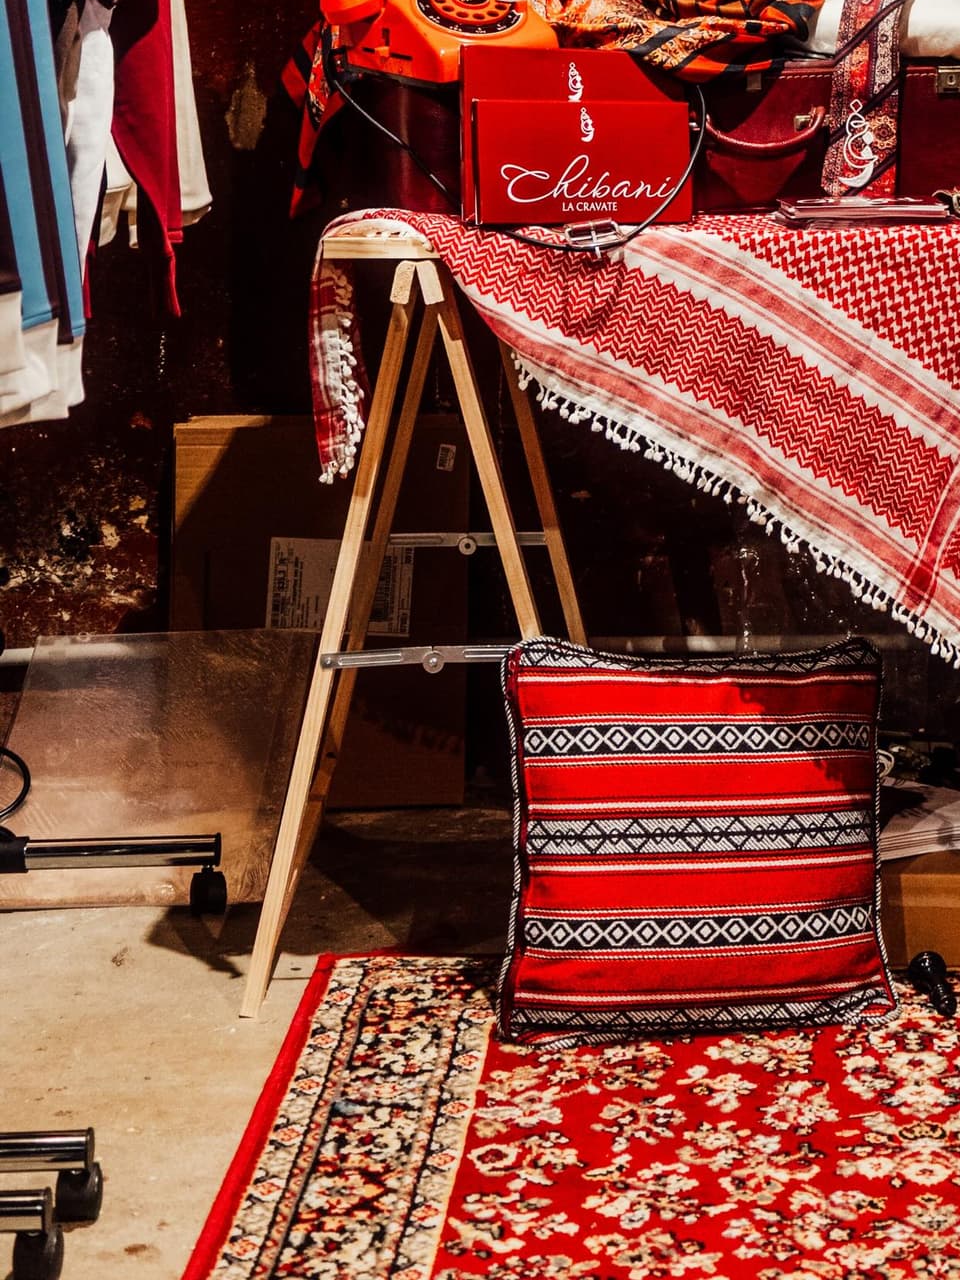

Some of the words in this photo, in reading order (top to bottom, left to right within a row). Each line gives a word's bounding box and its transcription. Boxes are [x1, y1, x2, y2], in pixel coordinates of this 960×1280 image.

[500, 154, 677, 203] Chibani
[562, 202, 575, 212] LA
[576, 201, 618, 212] CRAVATE
